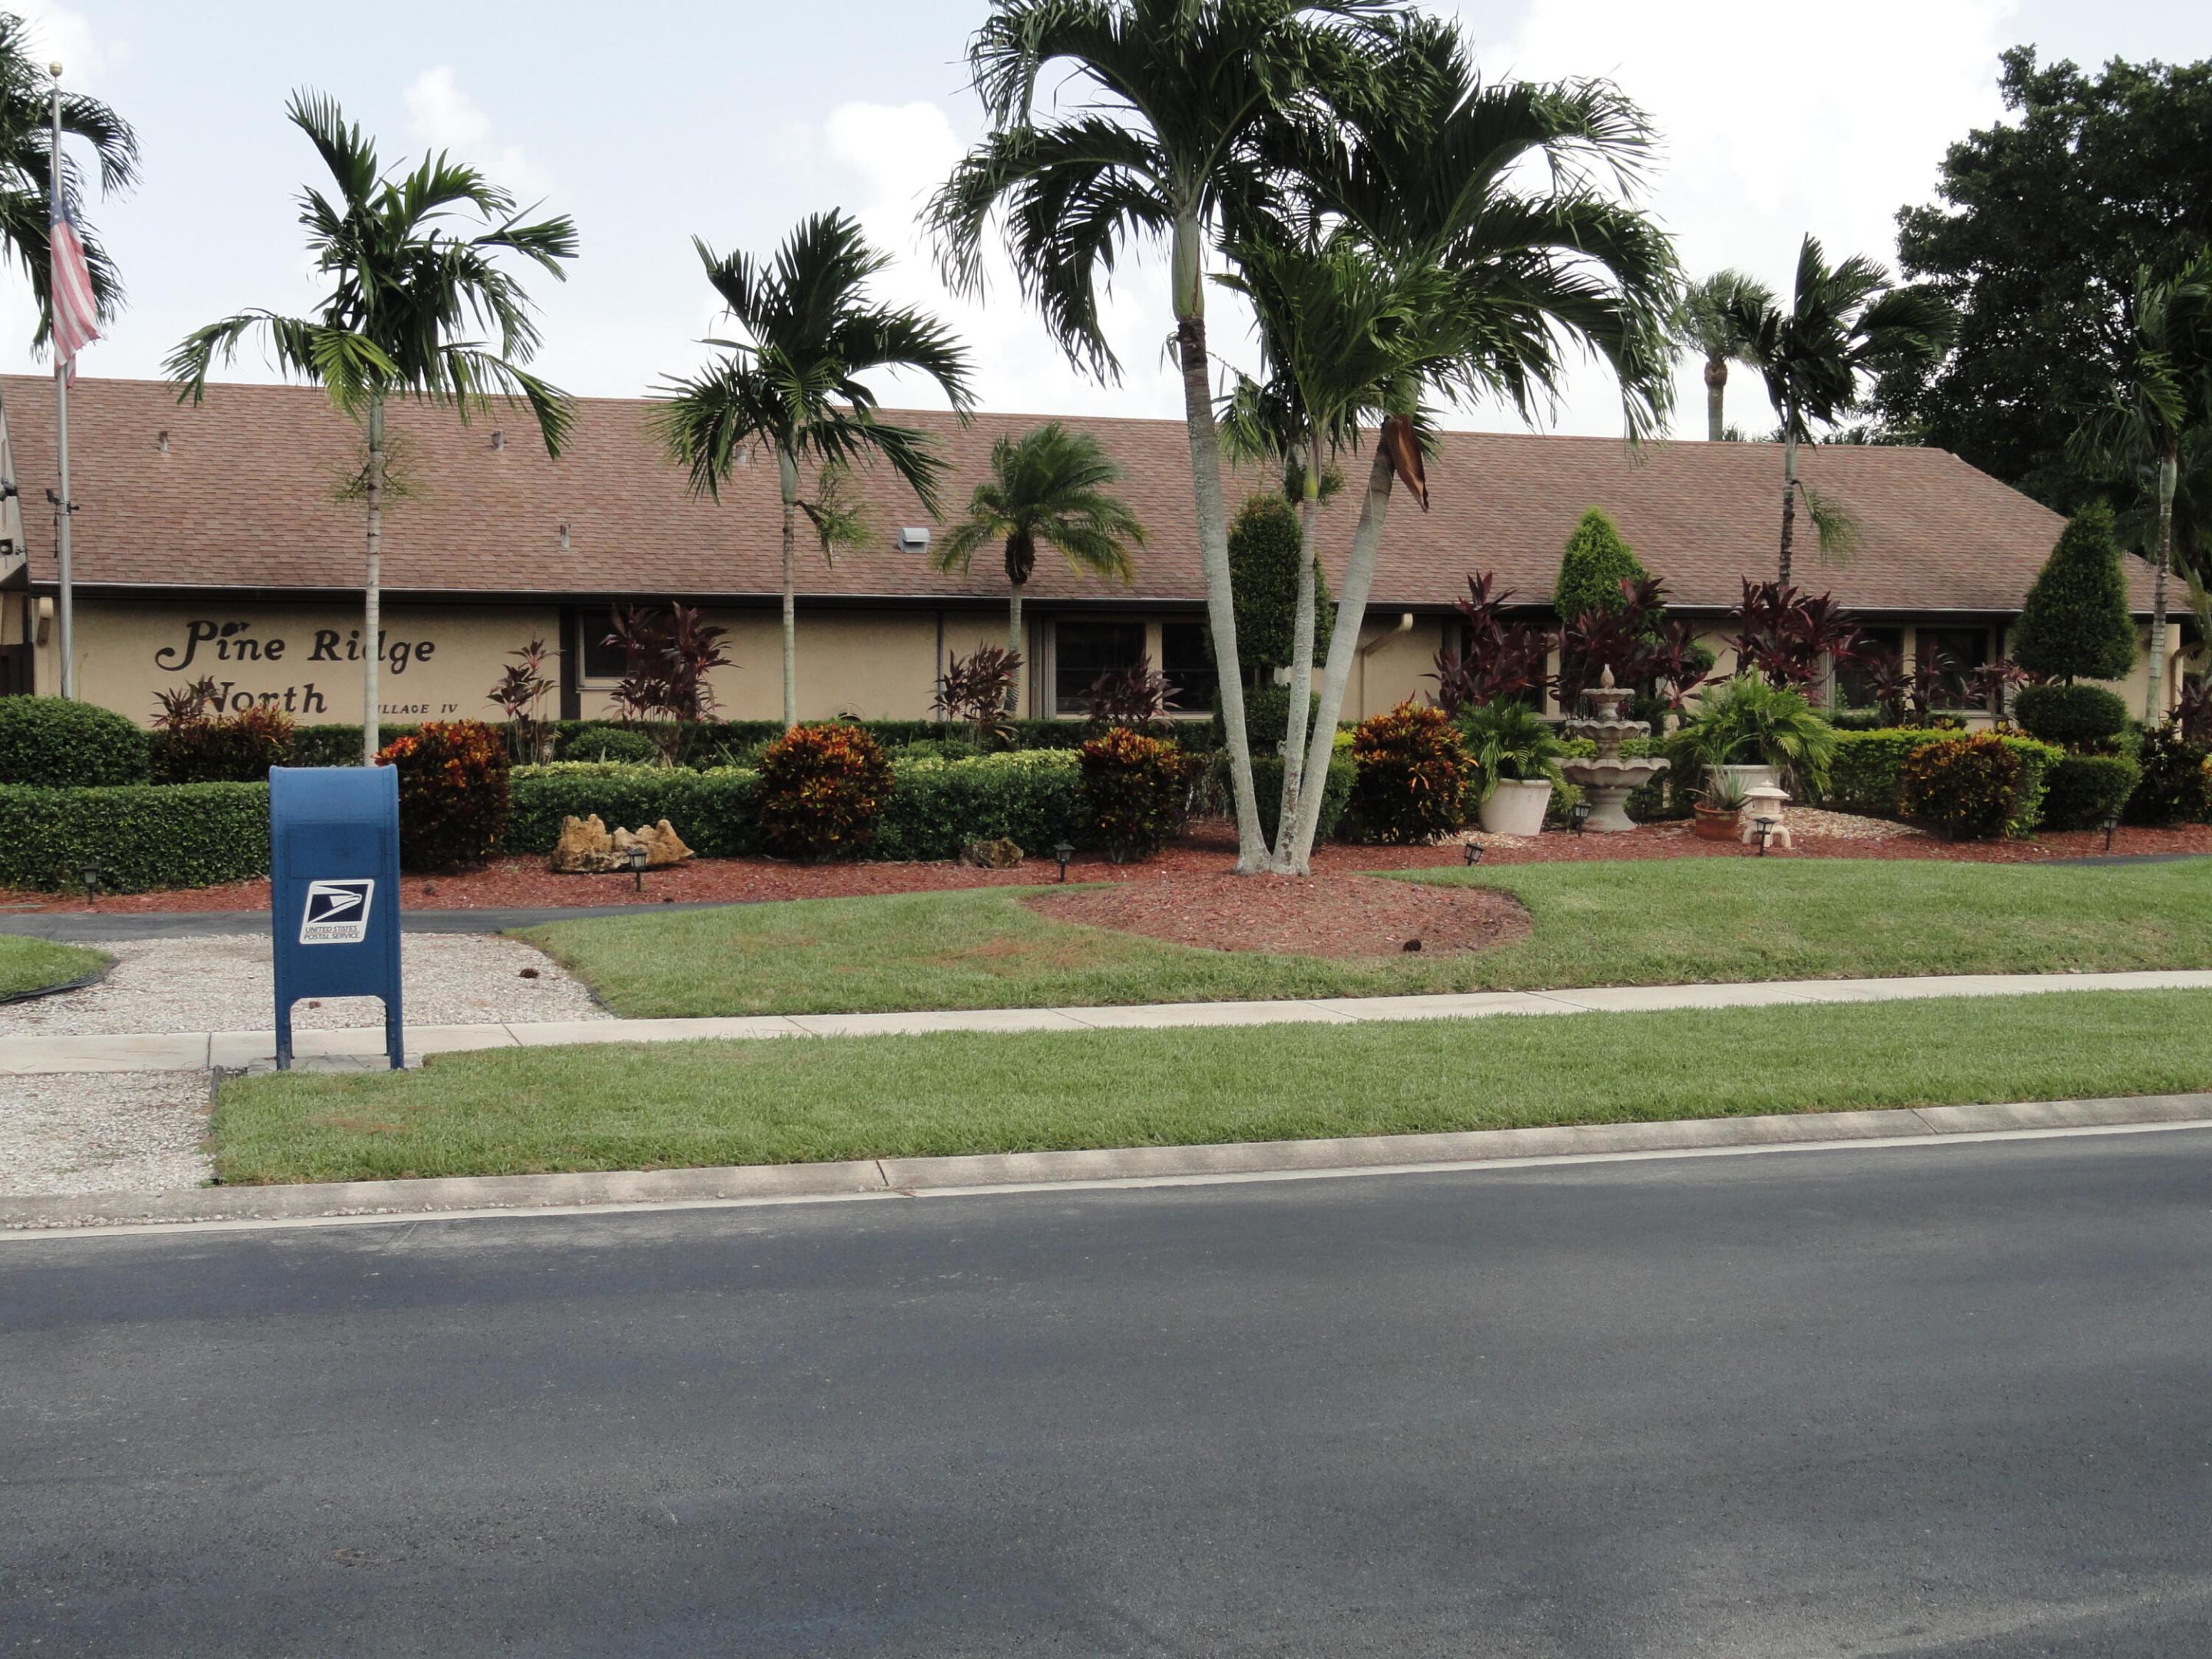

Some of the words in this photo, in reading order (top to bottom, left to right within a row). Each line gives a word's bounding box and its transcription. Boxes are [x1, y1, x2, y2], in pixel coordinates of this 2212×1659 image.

[155, 620, 286, 672] Pine
[376, 704, 429, 714] ILLAGE
[441, 704, 459, 714] IV
